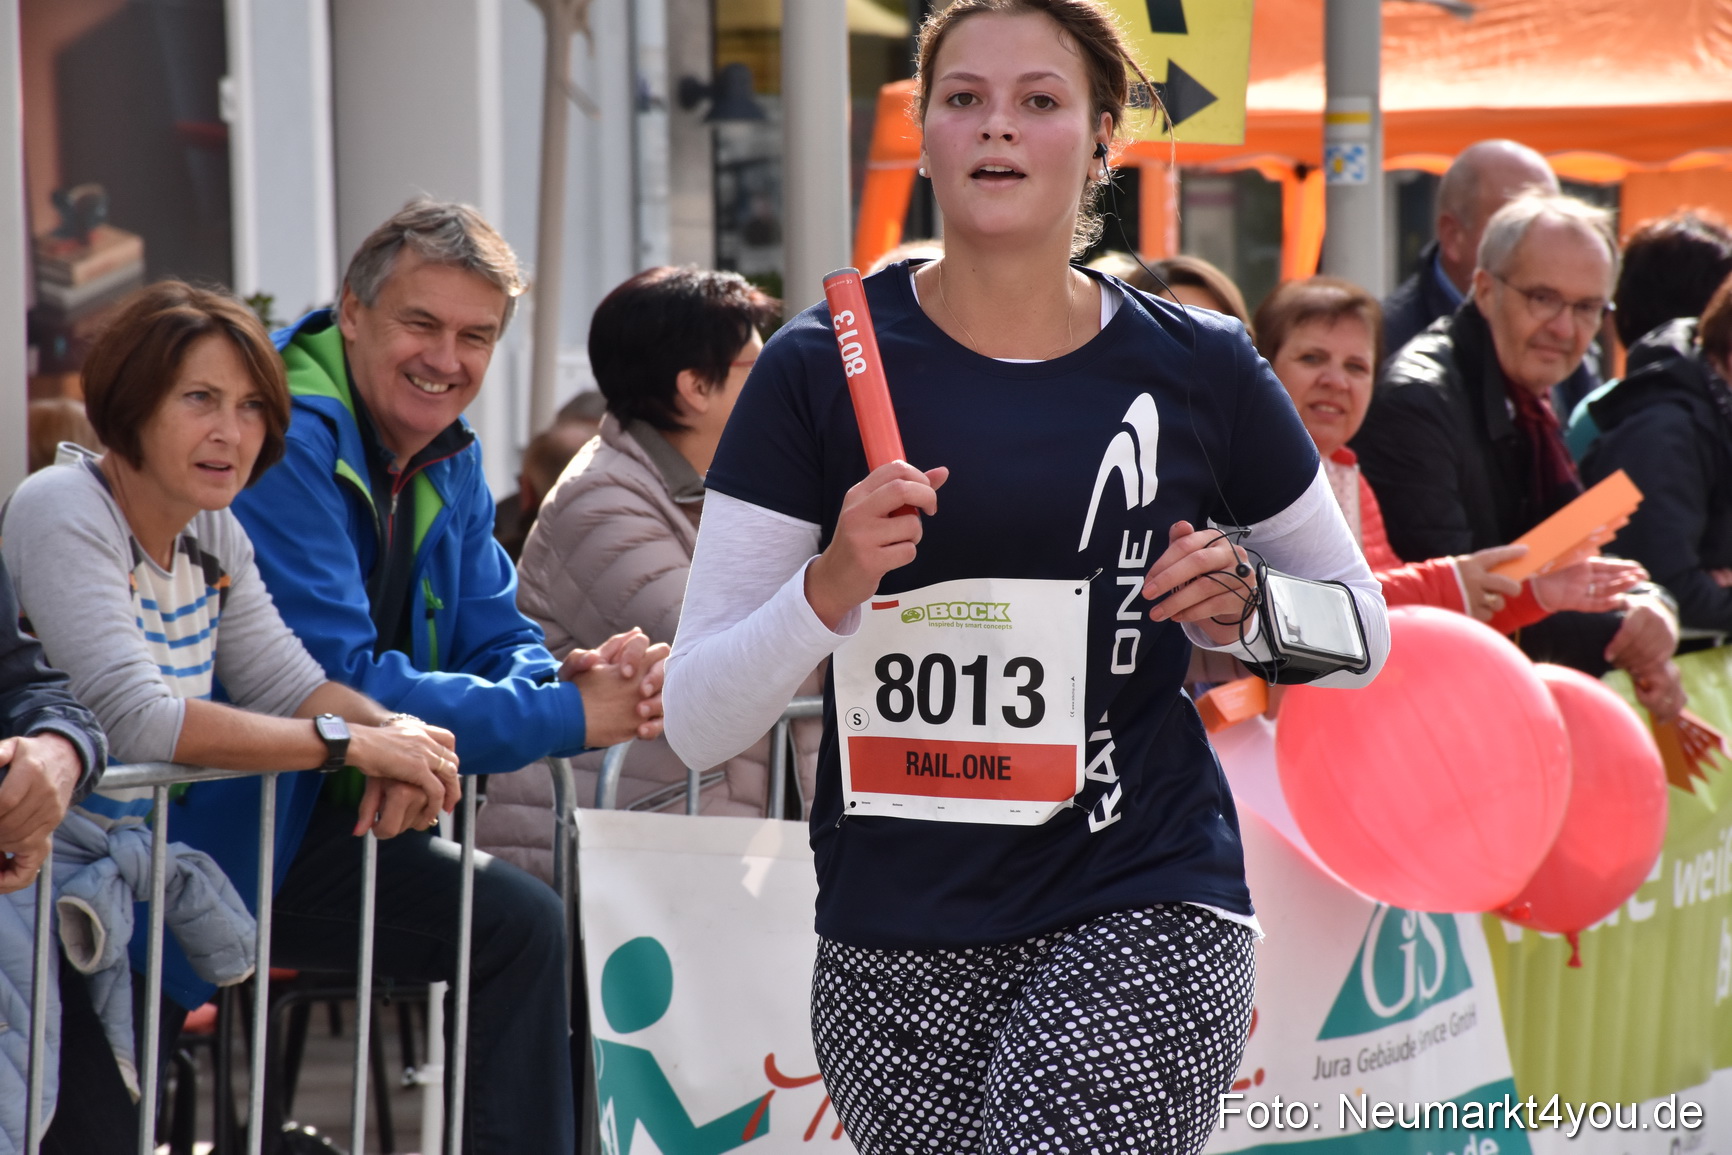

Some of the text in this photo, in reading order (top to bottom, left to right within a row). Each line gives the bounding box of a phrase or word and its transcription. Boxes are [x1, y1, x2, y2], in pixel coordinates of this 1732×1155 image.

[833, 310, 867, 378] 8013
[926, 601, 1012, 622] BOCK
[956, 621, 963, 629] by
[984, 622, 1013, 631] concepts
[874, 652, 1046, 729] 8013
[853, 713, 862, 726] S
[906, 751, 1012, 781] RAIL.ONE
[1313, 1055, 1351, 1081] Jura
